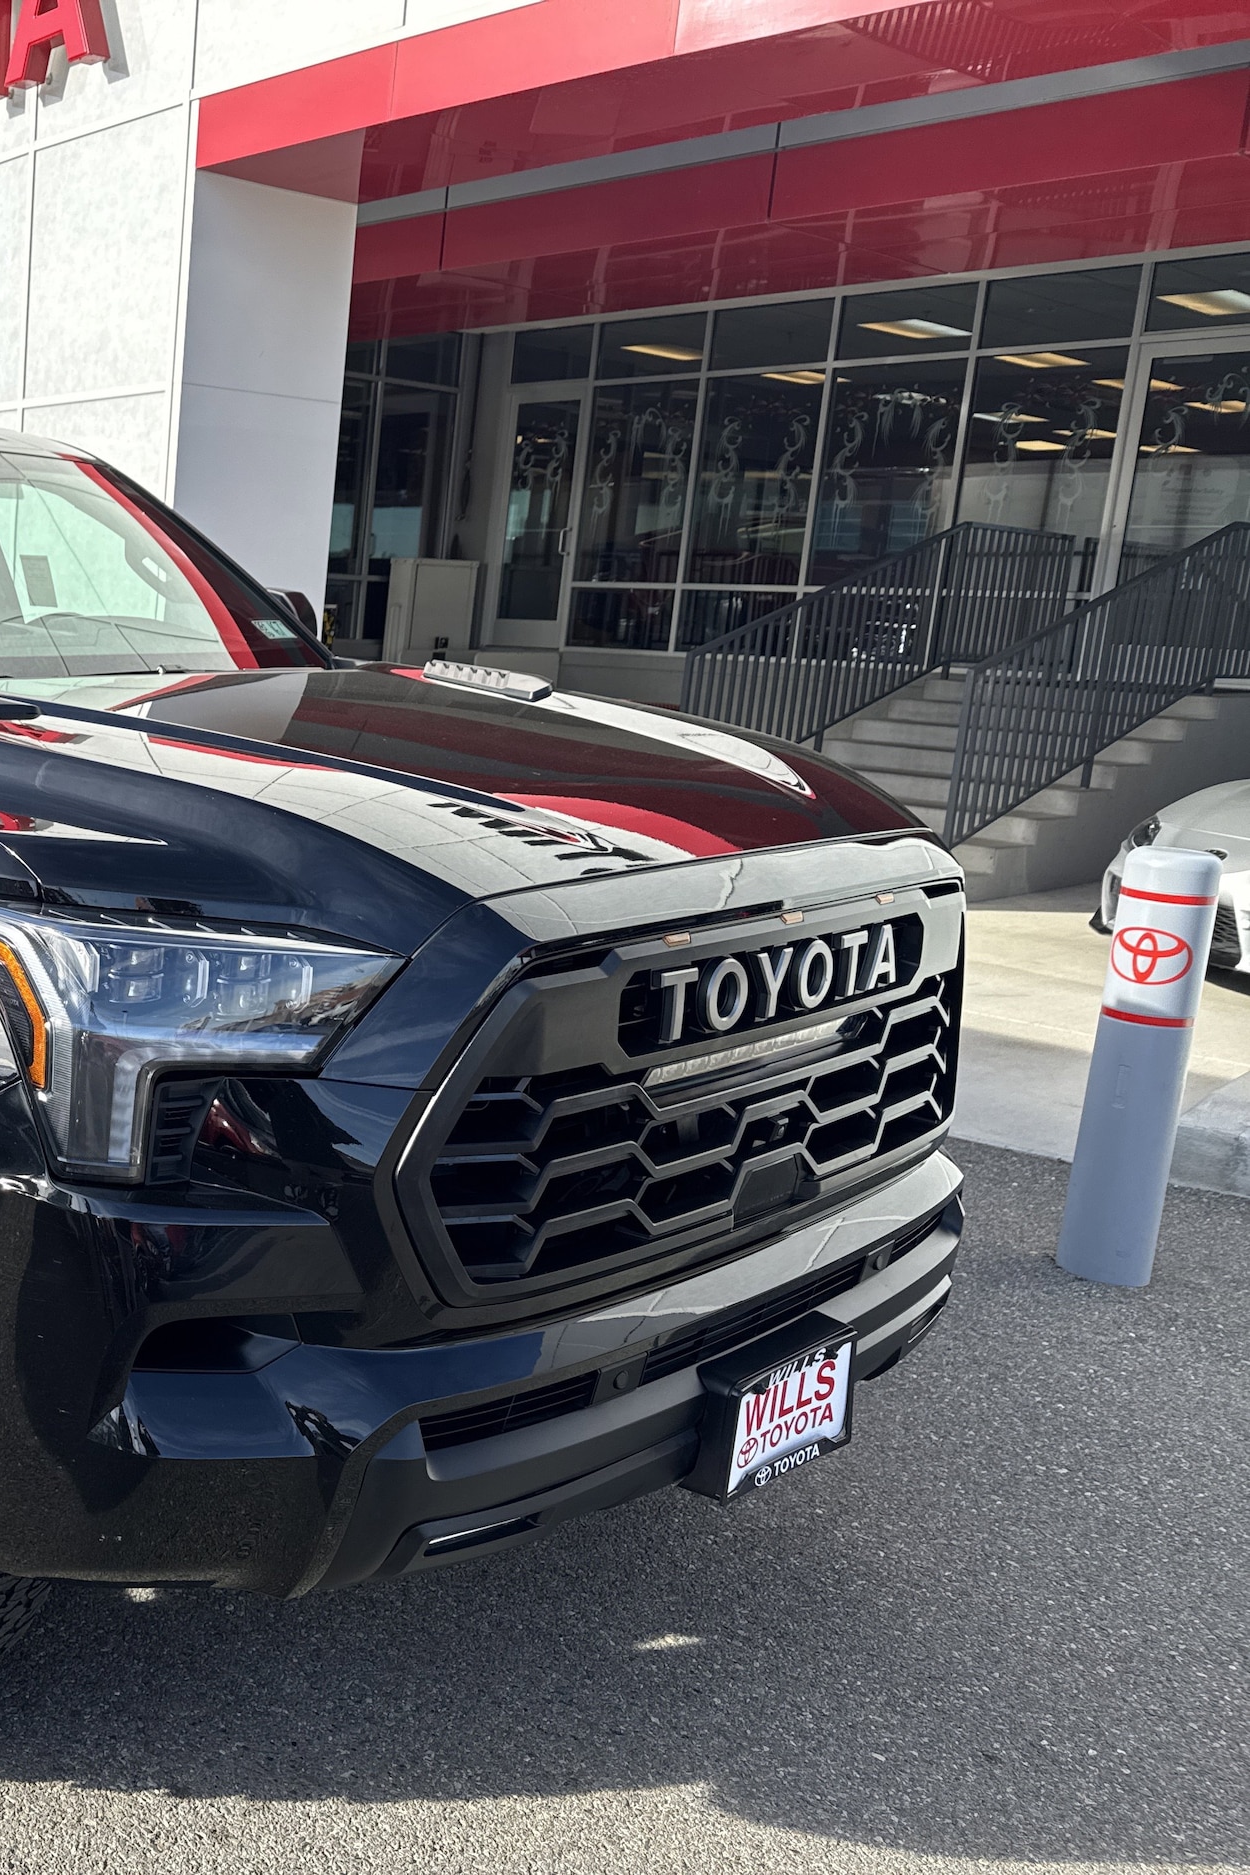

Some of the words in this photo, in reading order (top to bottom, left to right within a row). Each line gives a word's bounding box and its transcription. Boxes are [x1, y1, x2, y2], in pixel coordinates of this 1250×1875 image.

[659, 924, 896, 1043] TOYOTA
[769, 1347, 827, 1387] WILLS
[745, 1359, 836, 1438] WILLS
[760, 1402, 833, 1454] TOYOTA
[774, 1443, 820, 1477] TOYOTA
